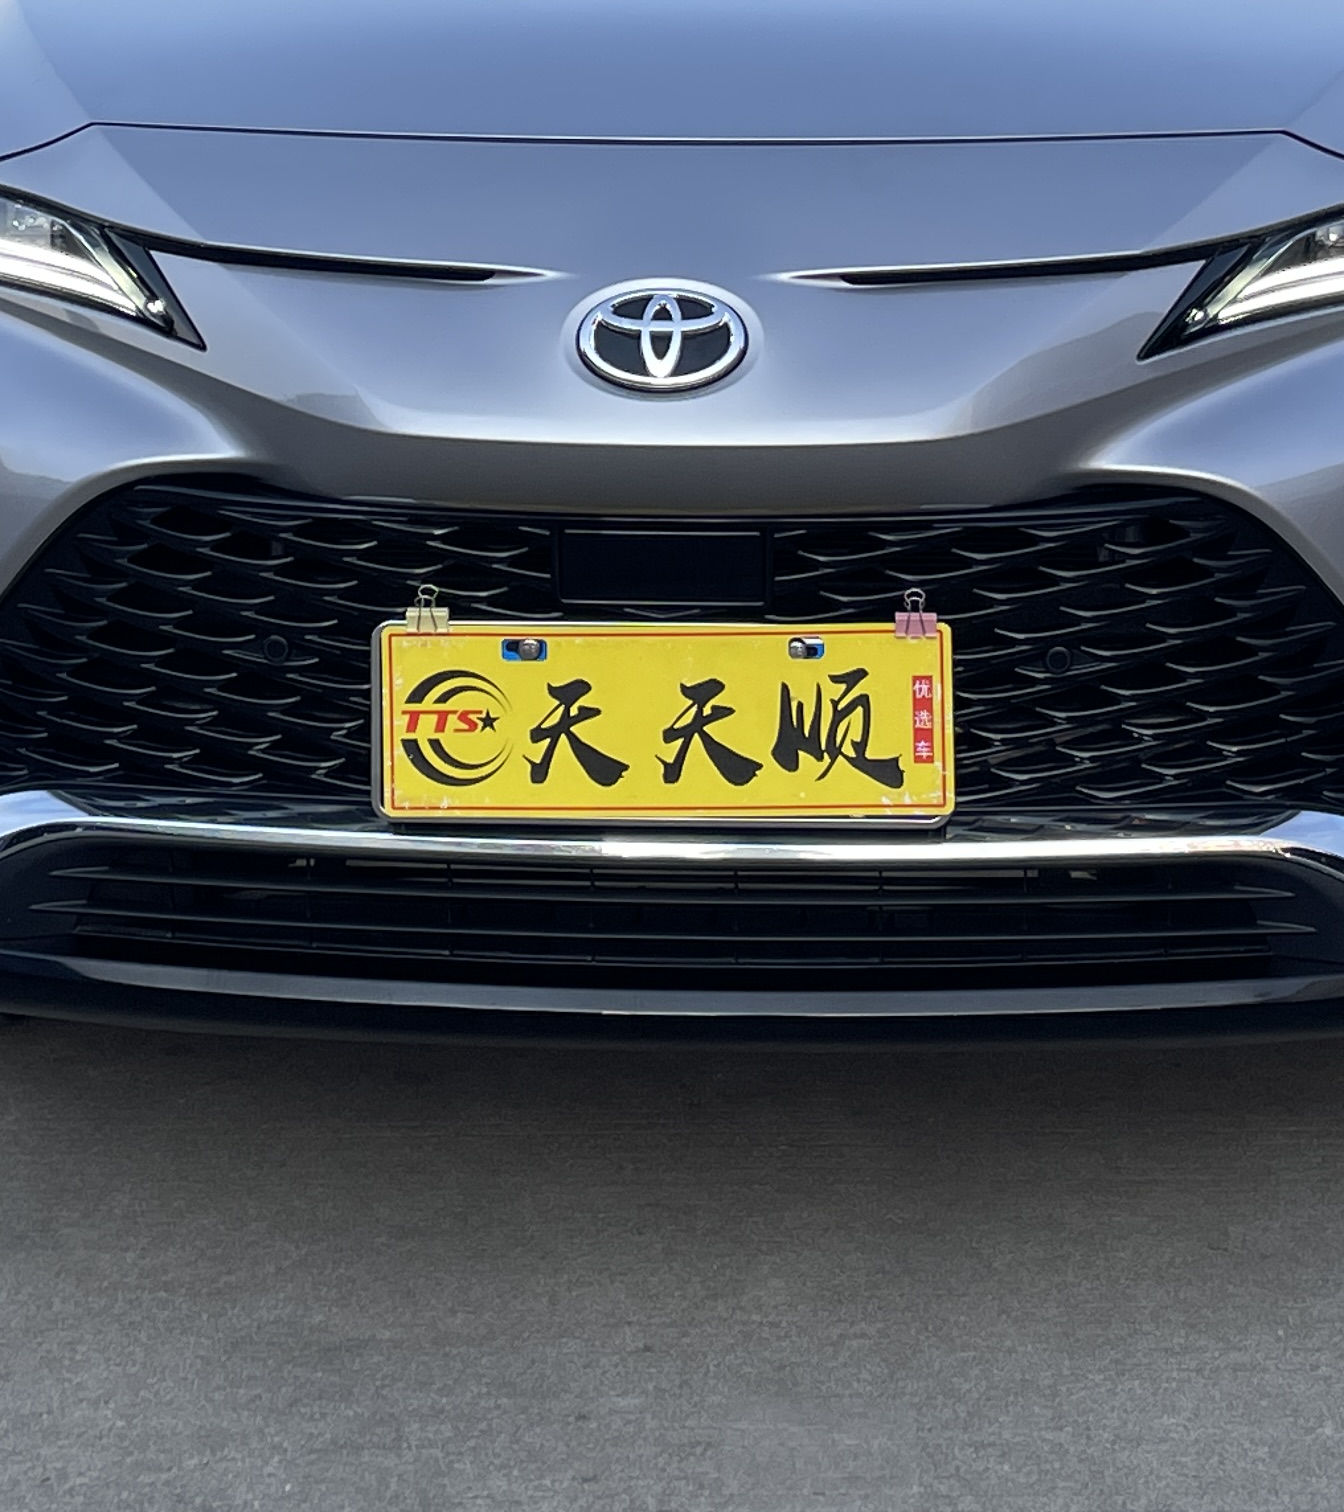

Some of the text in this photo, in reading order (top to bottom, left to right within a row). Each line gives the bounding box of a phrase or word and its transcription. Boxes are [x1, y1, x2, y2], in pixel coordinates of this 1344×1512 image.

[401, 710, 483, 733] TTS
[522, 668, 904, 789] 天天顺
[913, 679, 933, 759] 优选车
